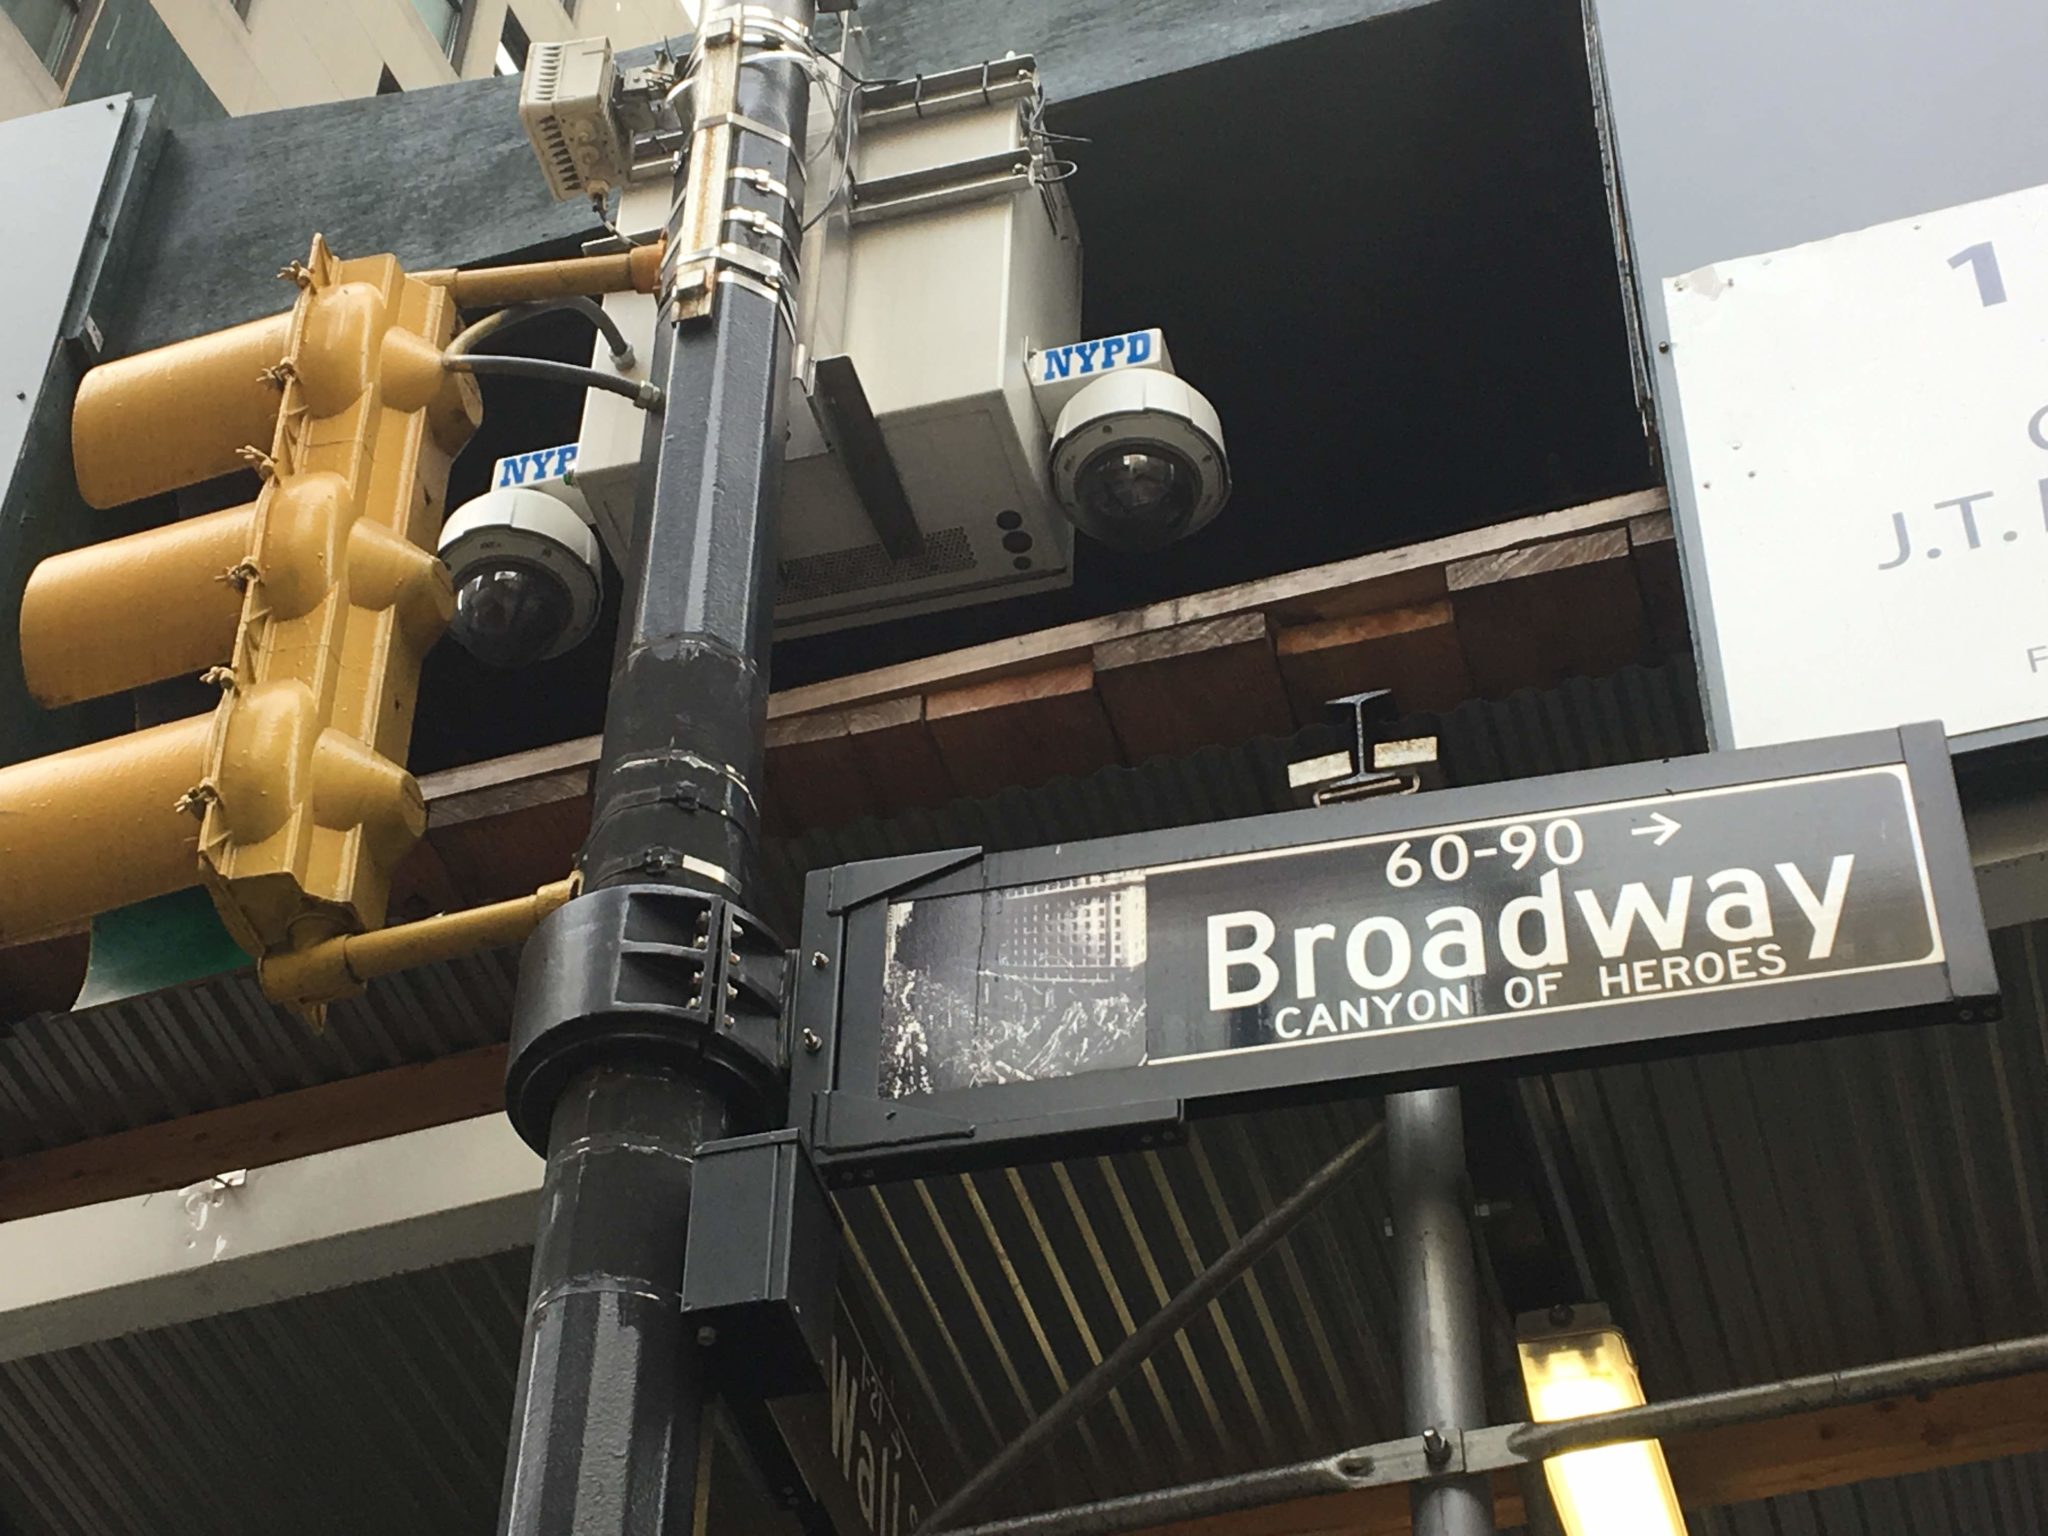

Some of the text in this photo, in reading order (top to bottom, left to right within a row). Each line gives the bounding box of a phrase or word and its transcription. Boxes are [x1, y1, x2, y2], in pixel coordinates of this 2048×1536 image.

[1947, 241, 2007, 308] 1
[1044, 332, 1151, 381] NYPD
[1878, 491, 2018, 571] J.T.
[1385, 818, 1585, 888] 60-90
[1207, 854, 1855, 1012] Broadway
[1275, 943, 1787, 1040] CANYON OF HEROES
[831, 1334, 900, 1536] Wall
